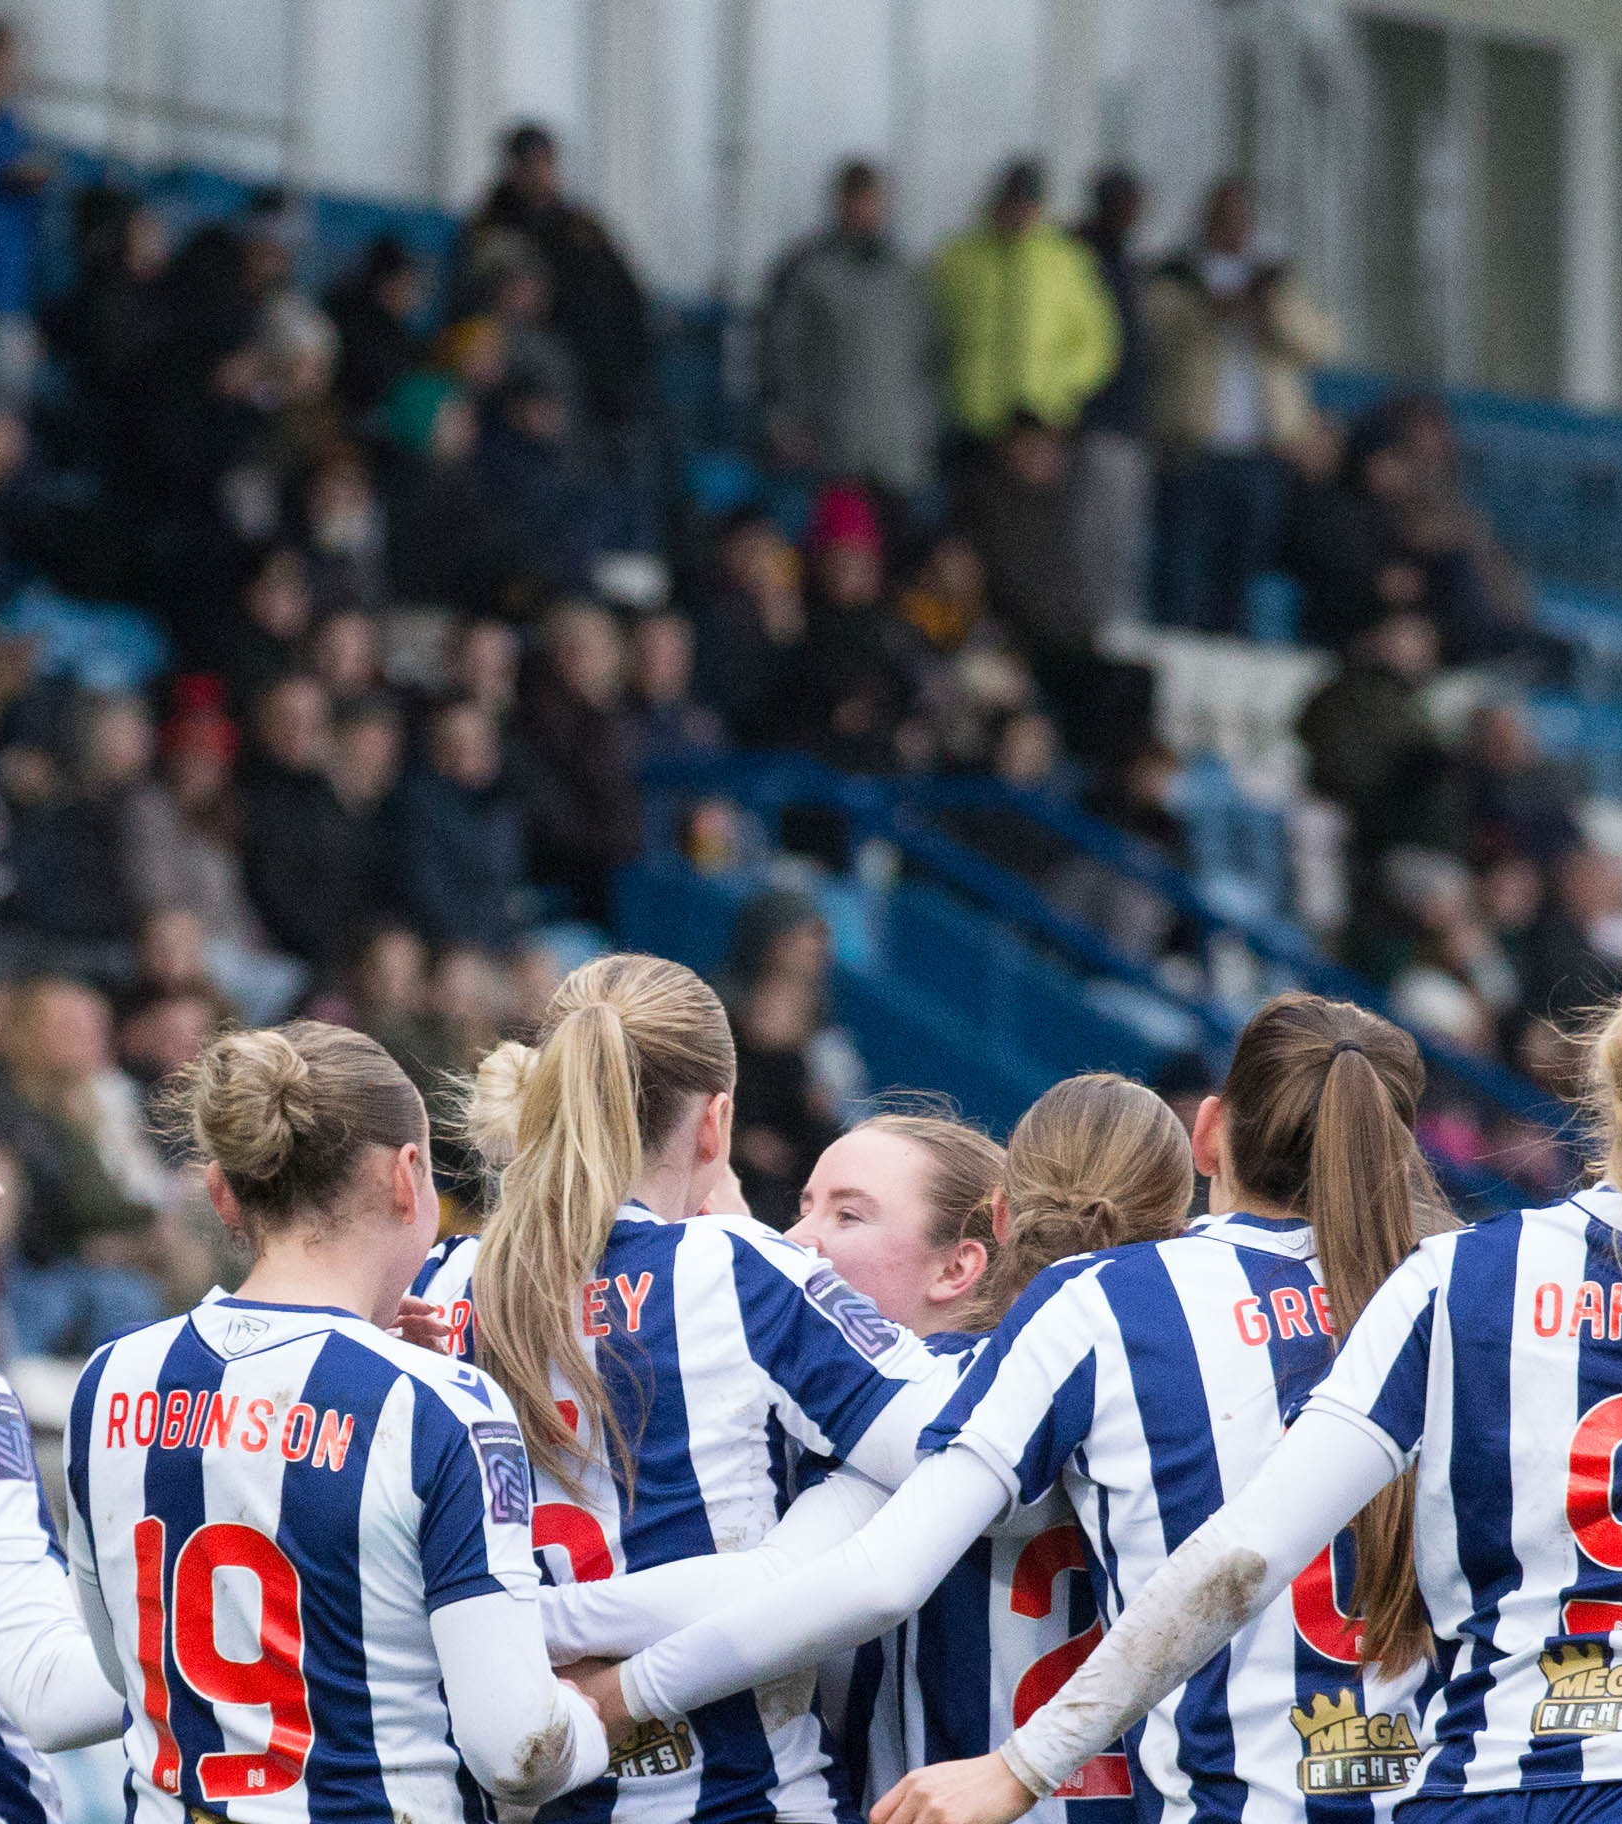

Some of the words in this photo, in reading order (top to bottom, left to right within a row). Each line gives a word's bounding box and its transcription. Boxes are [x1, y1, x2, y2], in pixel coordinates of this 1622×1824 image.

[106, 1390, 355, 1472] ROBINSON
[132, 1514, 315, 1802] 19
[1310, 1713, 1416, 1753] MEGA
[1309, 1756, 1419, 1787] RICHES
